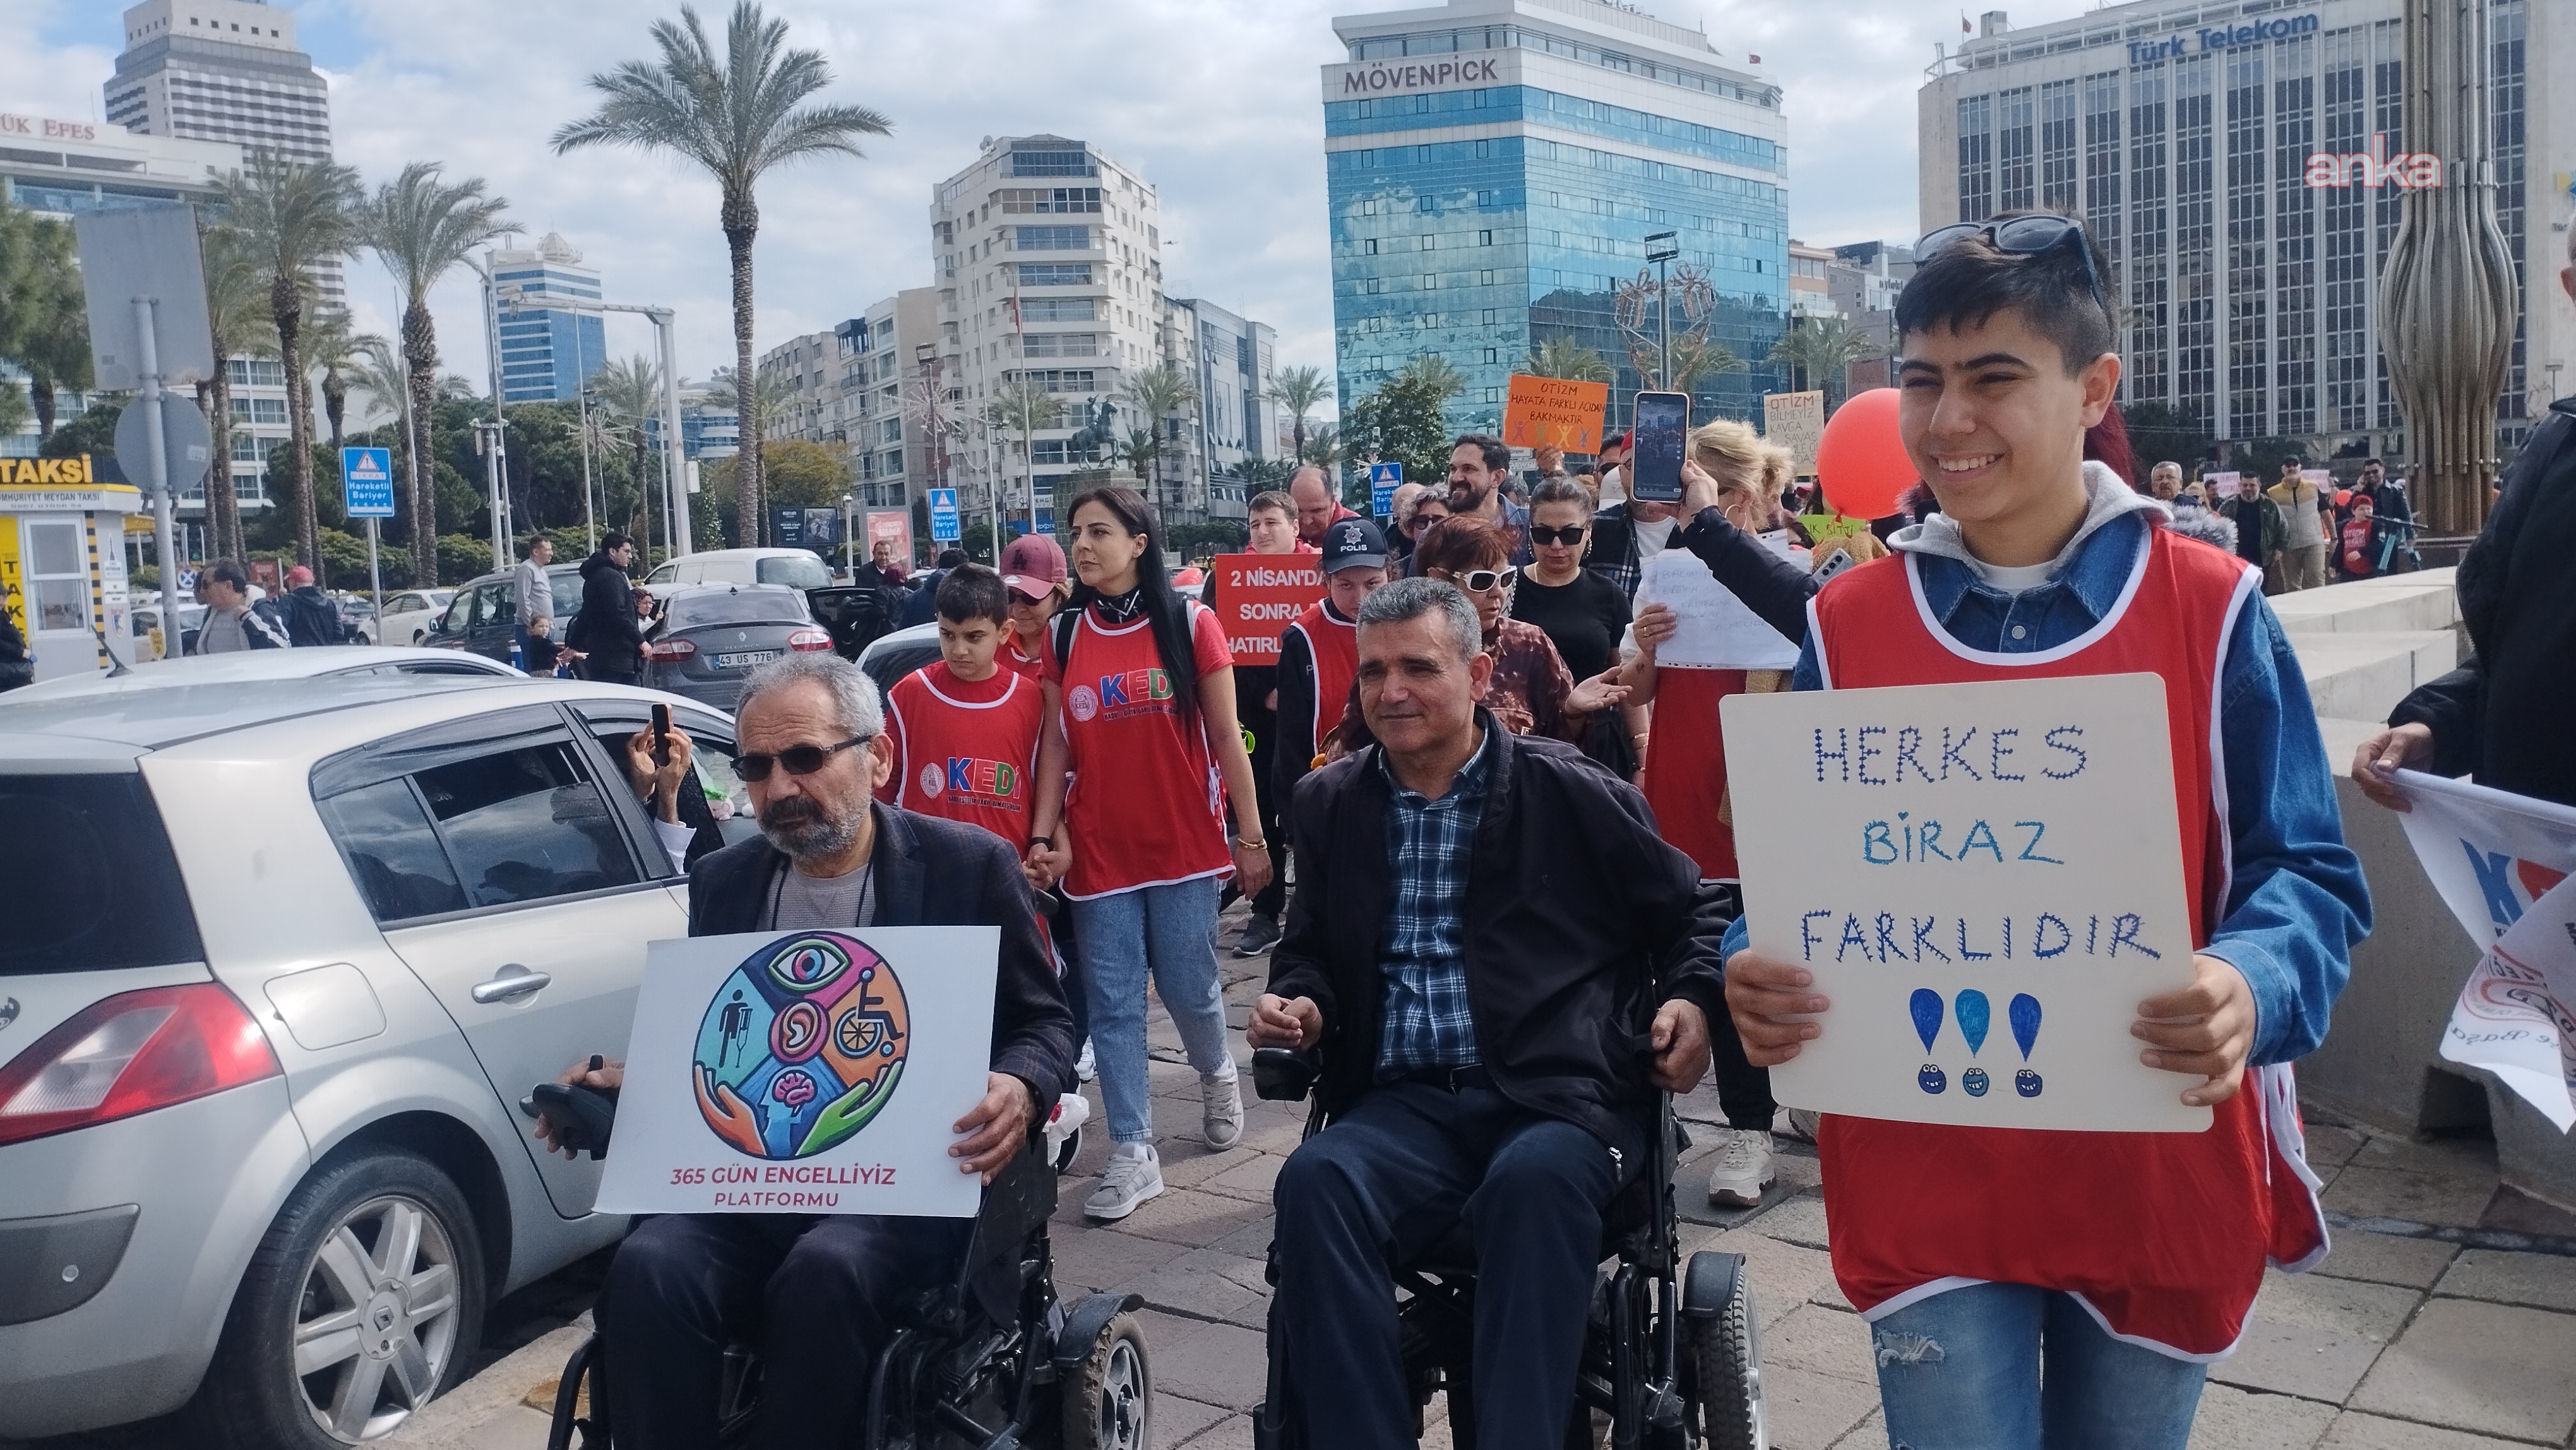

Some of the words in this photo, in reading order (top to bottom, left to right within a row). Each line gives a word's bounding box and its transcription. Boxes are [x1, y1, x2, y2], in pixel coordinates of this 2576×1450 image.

[2126, 35, 2185, 64] Türk
[2196, 13, 2319, 51] Telekom
[43, 119, 95, 140] EFES
[1541, 382, 1578, 396] OTİZM
[1511, 394, 1546, 407] HAYATA
[1549, 398, 1577, 409] FARKLI
[1530, 410, 1583, 424] BAKMAKTIR
[1770, 421, 1803, 434] KAVGA
[0, 453, 93, 484] TAKSİ
[349, 482, 390, 490] Hareketli
[352, 491, 386, 501] Bariyer
[1231, 570, 1241, 587] 2
[1240, 603, 1303, 620] SONRA
[720, 656, 731, 664] 43
[737, 654, 749, 663] US
[754, 653, 772, 662] 776
[1815, 726, 2087, 786] HERKES
[1801, 909, 2162, 965] FARKLIDIR
[670, 1168, 705, 1185] 365
[712, 1163, 759, 1183] GÜN
[764, 1163, 897, 1185] ENGELLİYİZ
[714, 1192, 839, 1207] PLATFORMU
